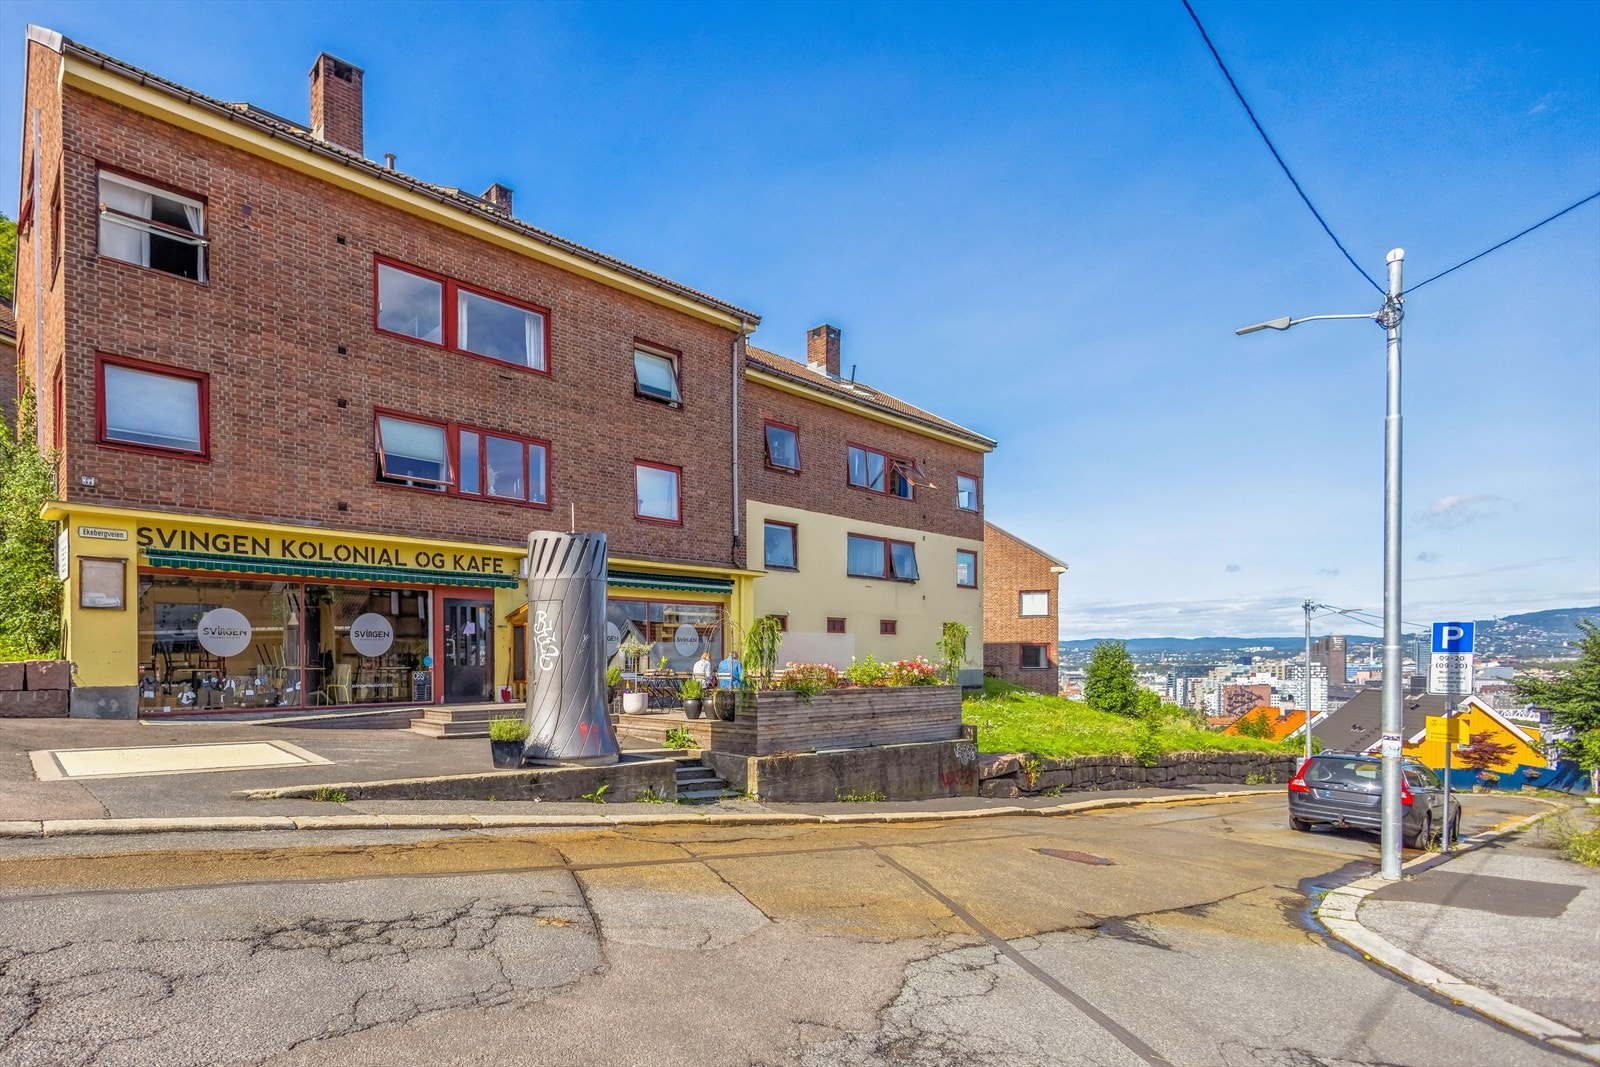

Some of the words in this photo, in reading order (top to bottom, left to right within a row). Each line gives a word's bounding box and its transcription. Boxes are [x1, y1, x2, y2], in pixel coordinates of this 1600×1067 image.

[82, 528, 124, 539] Ekebergveien
[136, 526, 270, 556] SVINGEN
[281, 539, 407, 567] KOLONIAL
[415, 551, 445, 569] OG
[453, 554, 504, 574] KAFE
[203, 625, 247, 636] SVINGEN
[354, 629, 390, 638] SVINGEN
[1441, 625, 1464, 649] P
